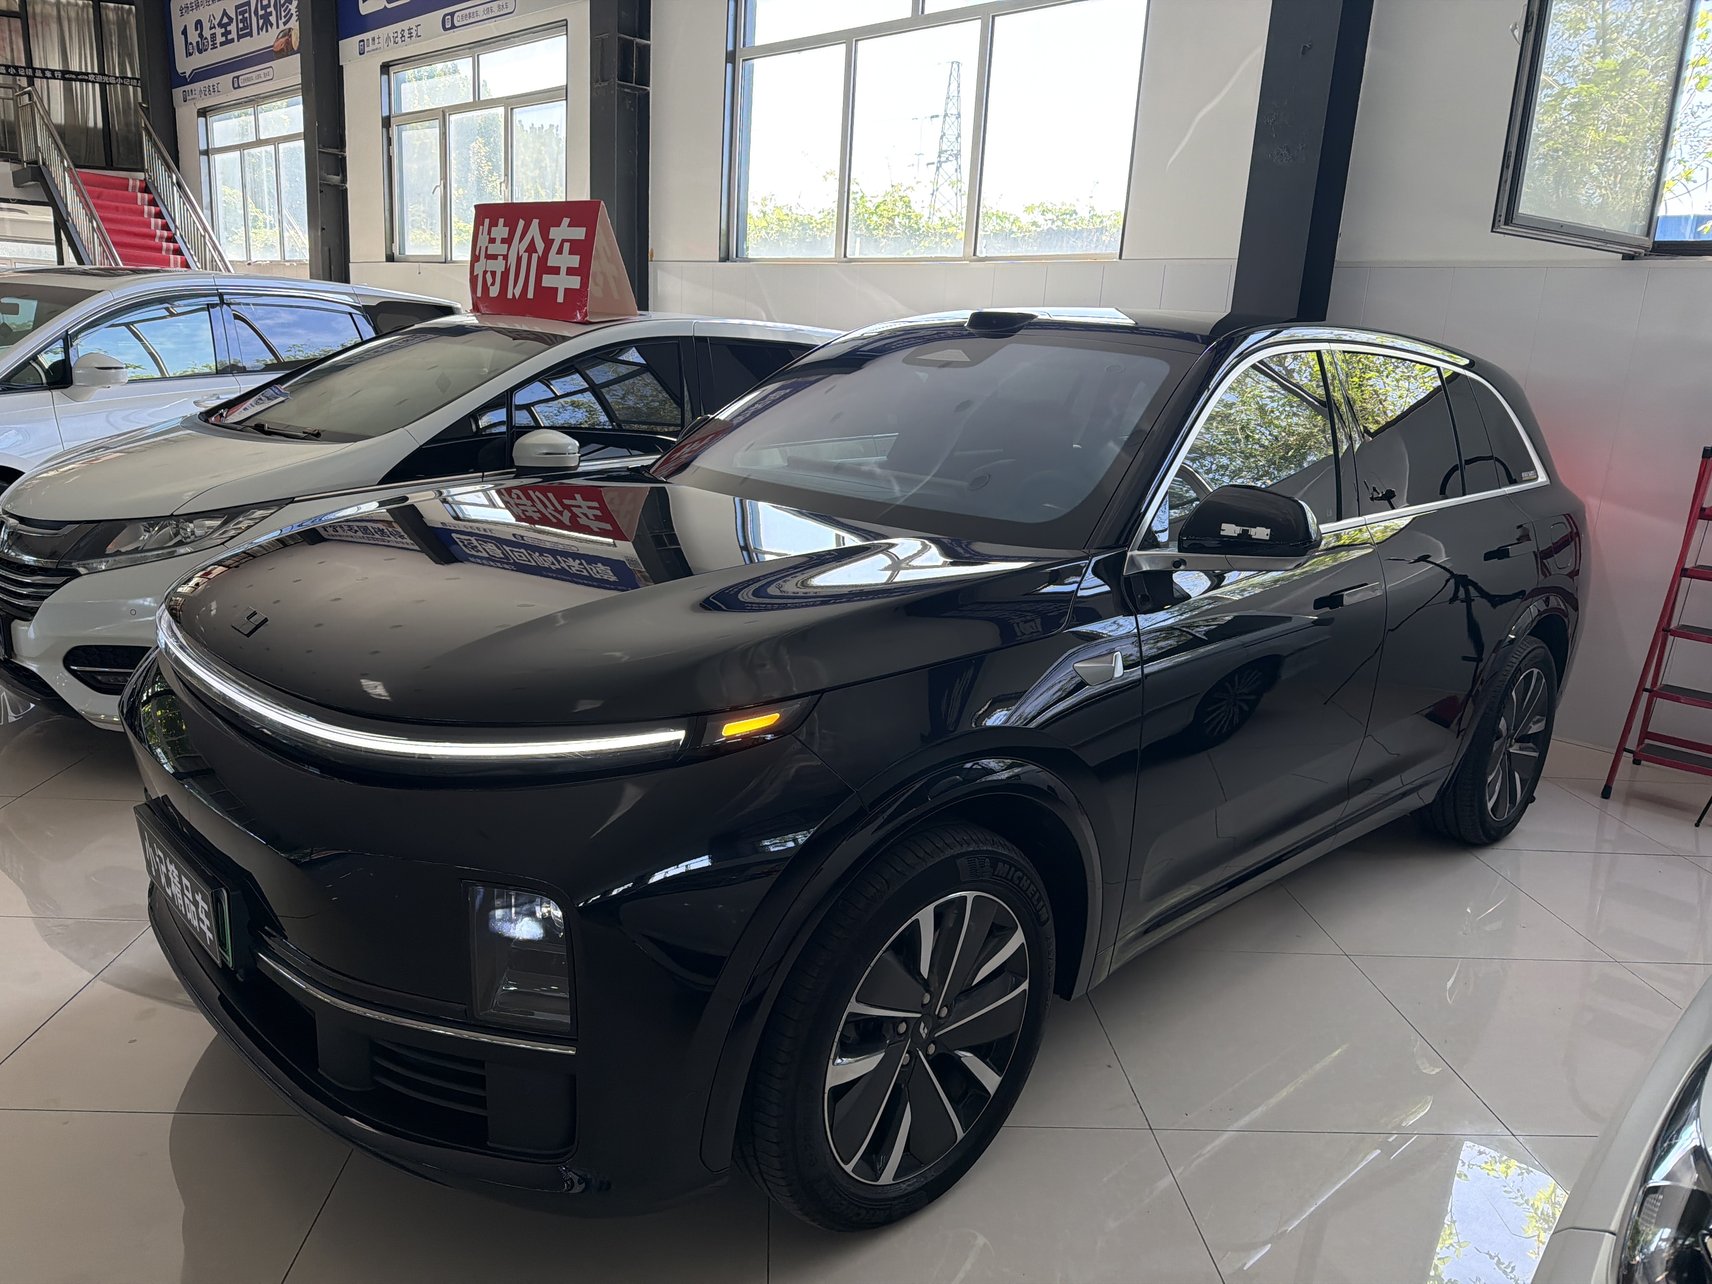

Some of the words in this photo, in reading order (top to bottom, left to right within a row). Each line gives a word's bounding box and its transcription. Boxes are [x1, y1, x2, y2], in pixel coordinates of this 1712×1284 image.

[384, 24, 422, 47] 小记名车汇
[474, 218, 586, 303] 特价车
[143, 831, 214, 945] 小记精品车
[994, 862, 1049, 922] MICHELIN
